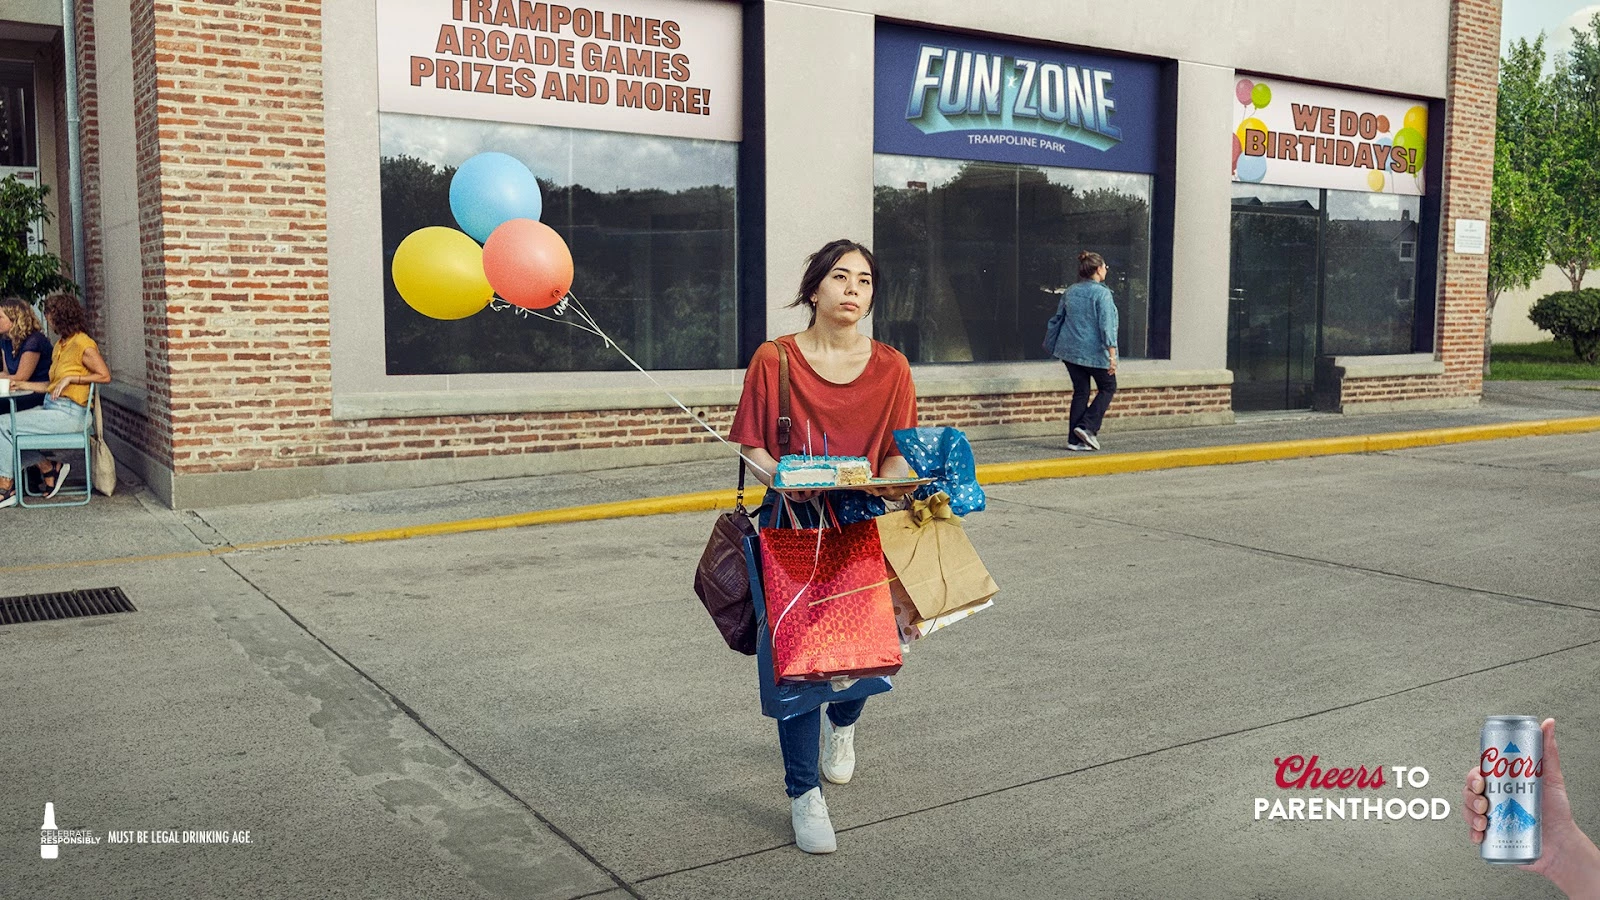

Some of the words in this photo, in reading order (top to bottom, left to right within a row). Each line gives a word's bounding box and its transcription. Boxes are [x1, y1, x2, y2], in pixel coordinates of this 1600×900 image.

[451, 0, 681, 50] TRAMPOLINES
[435, 23, 575, 69] ARCADE
[581, 42, 690, 83] GAMES
[410, 55, 537, 98] PRIZES
[541, 71, 610, 105] AND
[616, 79, 711, 116] MORE!
[905, 43, 1002, 119] FUN
[1012, 57, 1123, 142] ZONE
[967, 134, 1038, 148] TRAMPOLINE
[1039, 139, 1066, 154] PARK
[1291, 102, 1336, 135] WE
[1340, 110, 1378, 140] DO
[1244, 128, 1417, 174] BIRTHDAYS!
[1480, 747, 1544, 778] Coors
[1488, 781, 1536, 794] LIGHT
